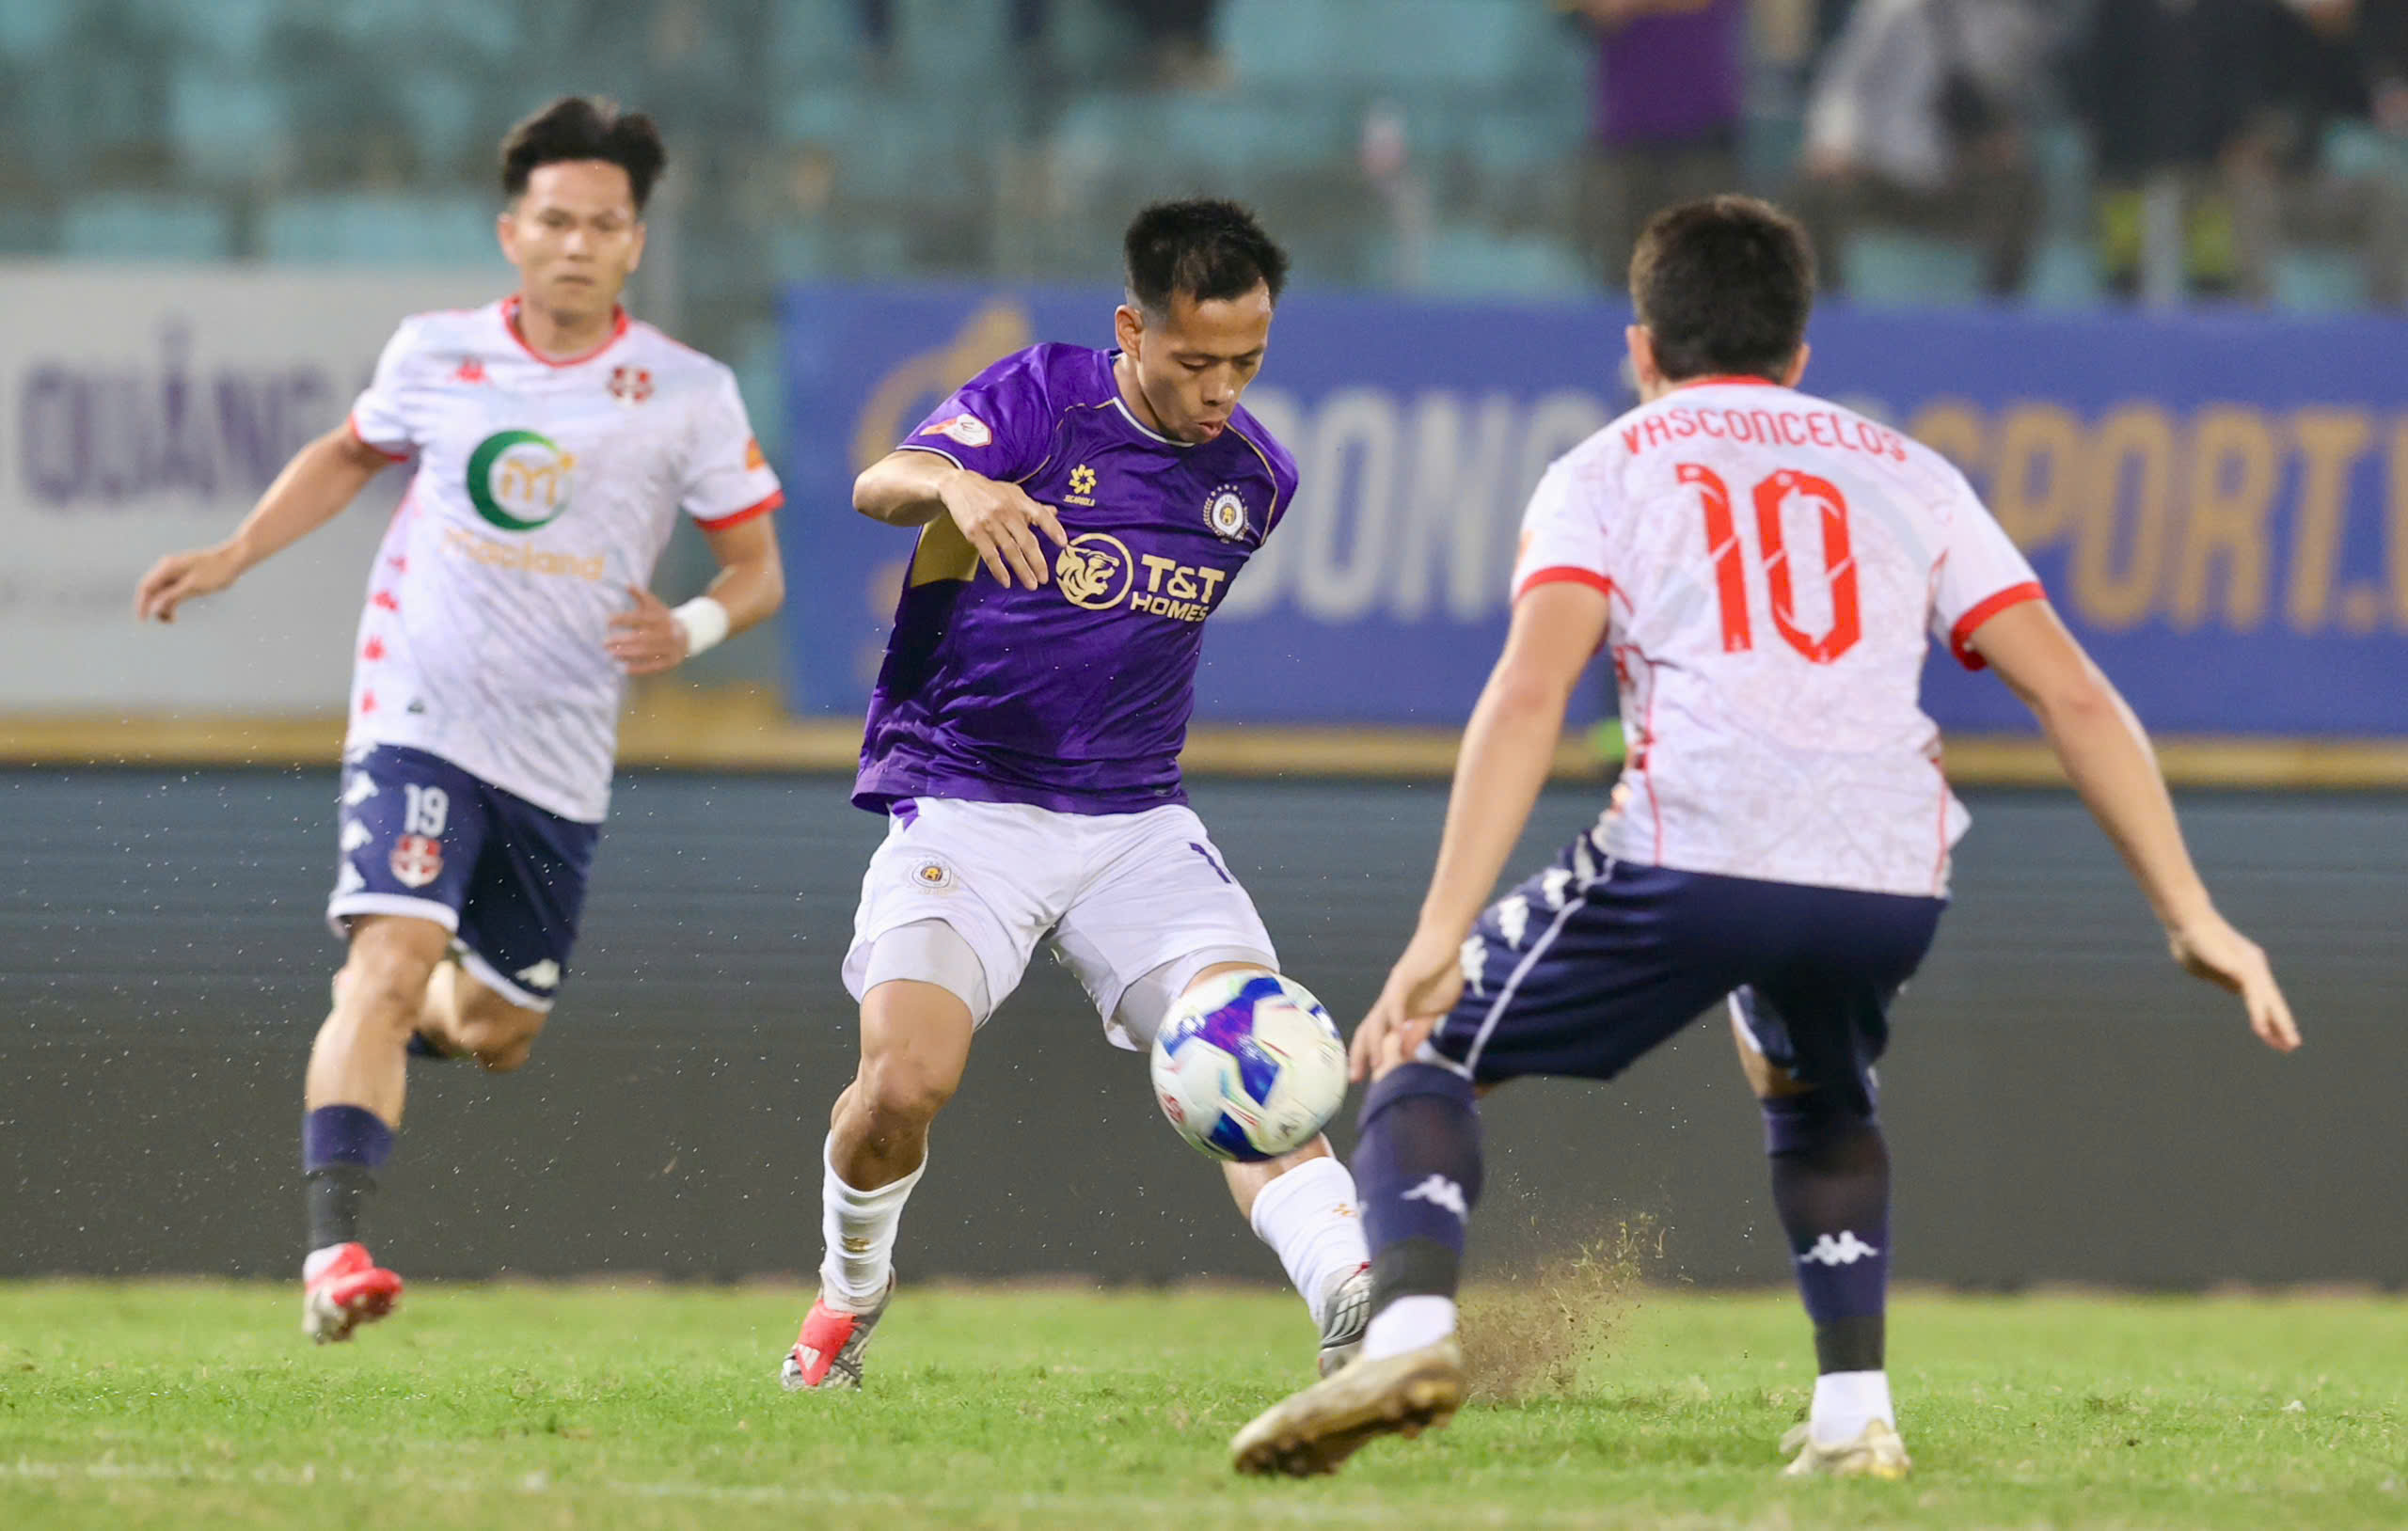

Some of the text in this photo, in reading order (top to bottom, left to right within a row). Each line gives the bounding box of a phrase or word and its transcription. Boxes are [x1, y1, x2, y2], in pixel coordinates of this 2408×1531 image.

[1621, 407, 1908, 463] VASCONCELOS
[1141, 554, 1226, 604] T&T
[1674, 463, 1862, 665] 10
[1130, 591, 1210, 623] HOMES
[404, 782, 450, 839] 19
